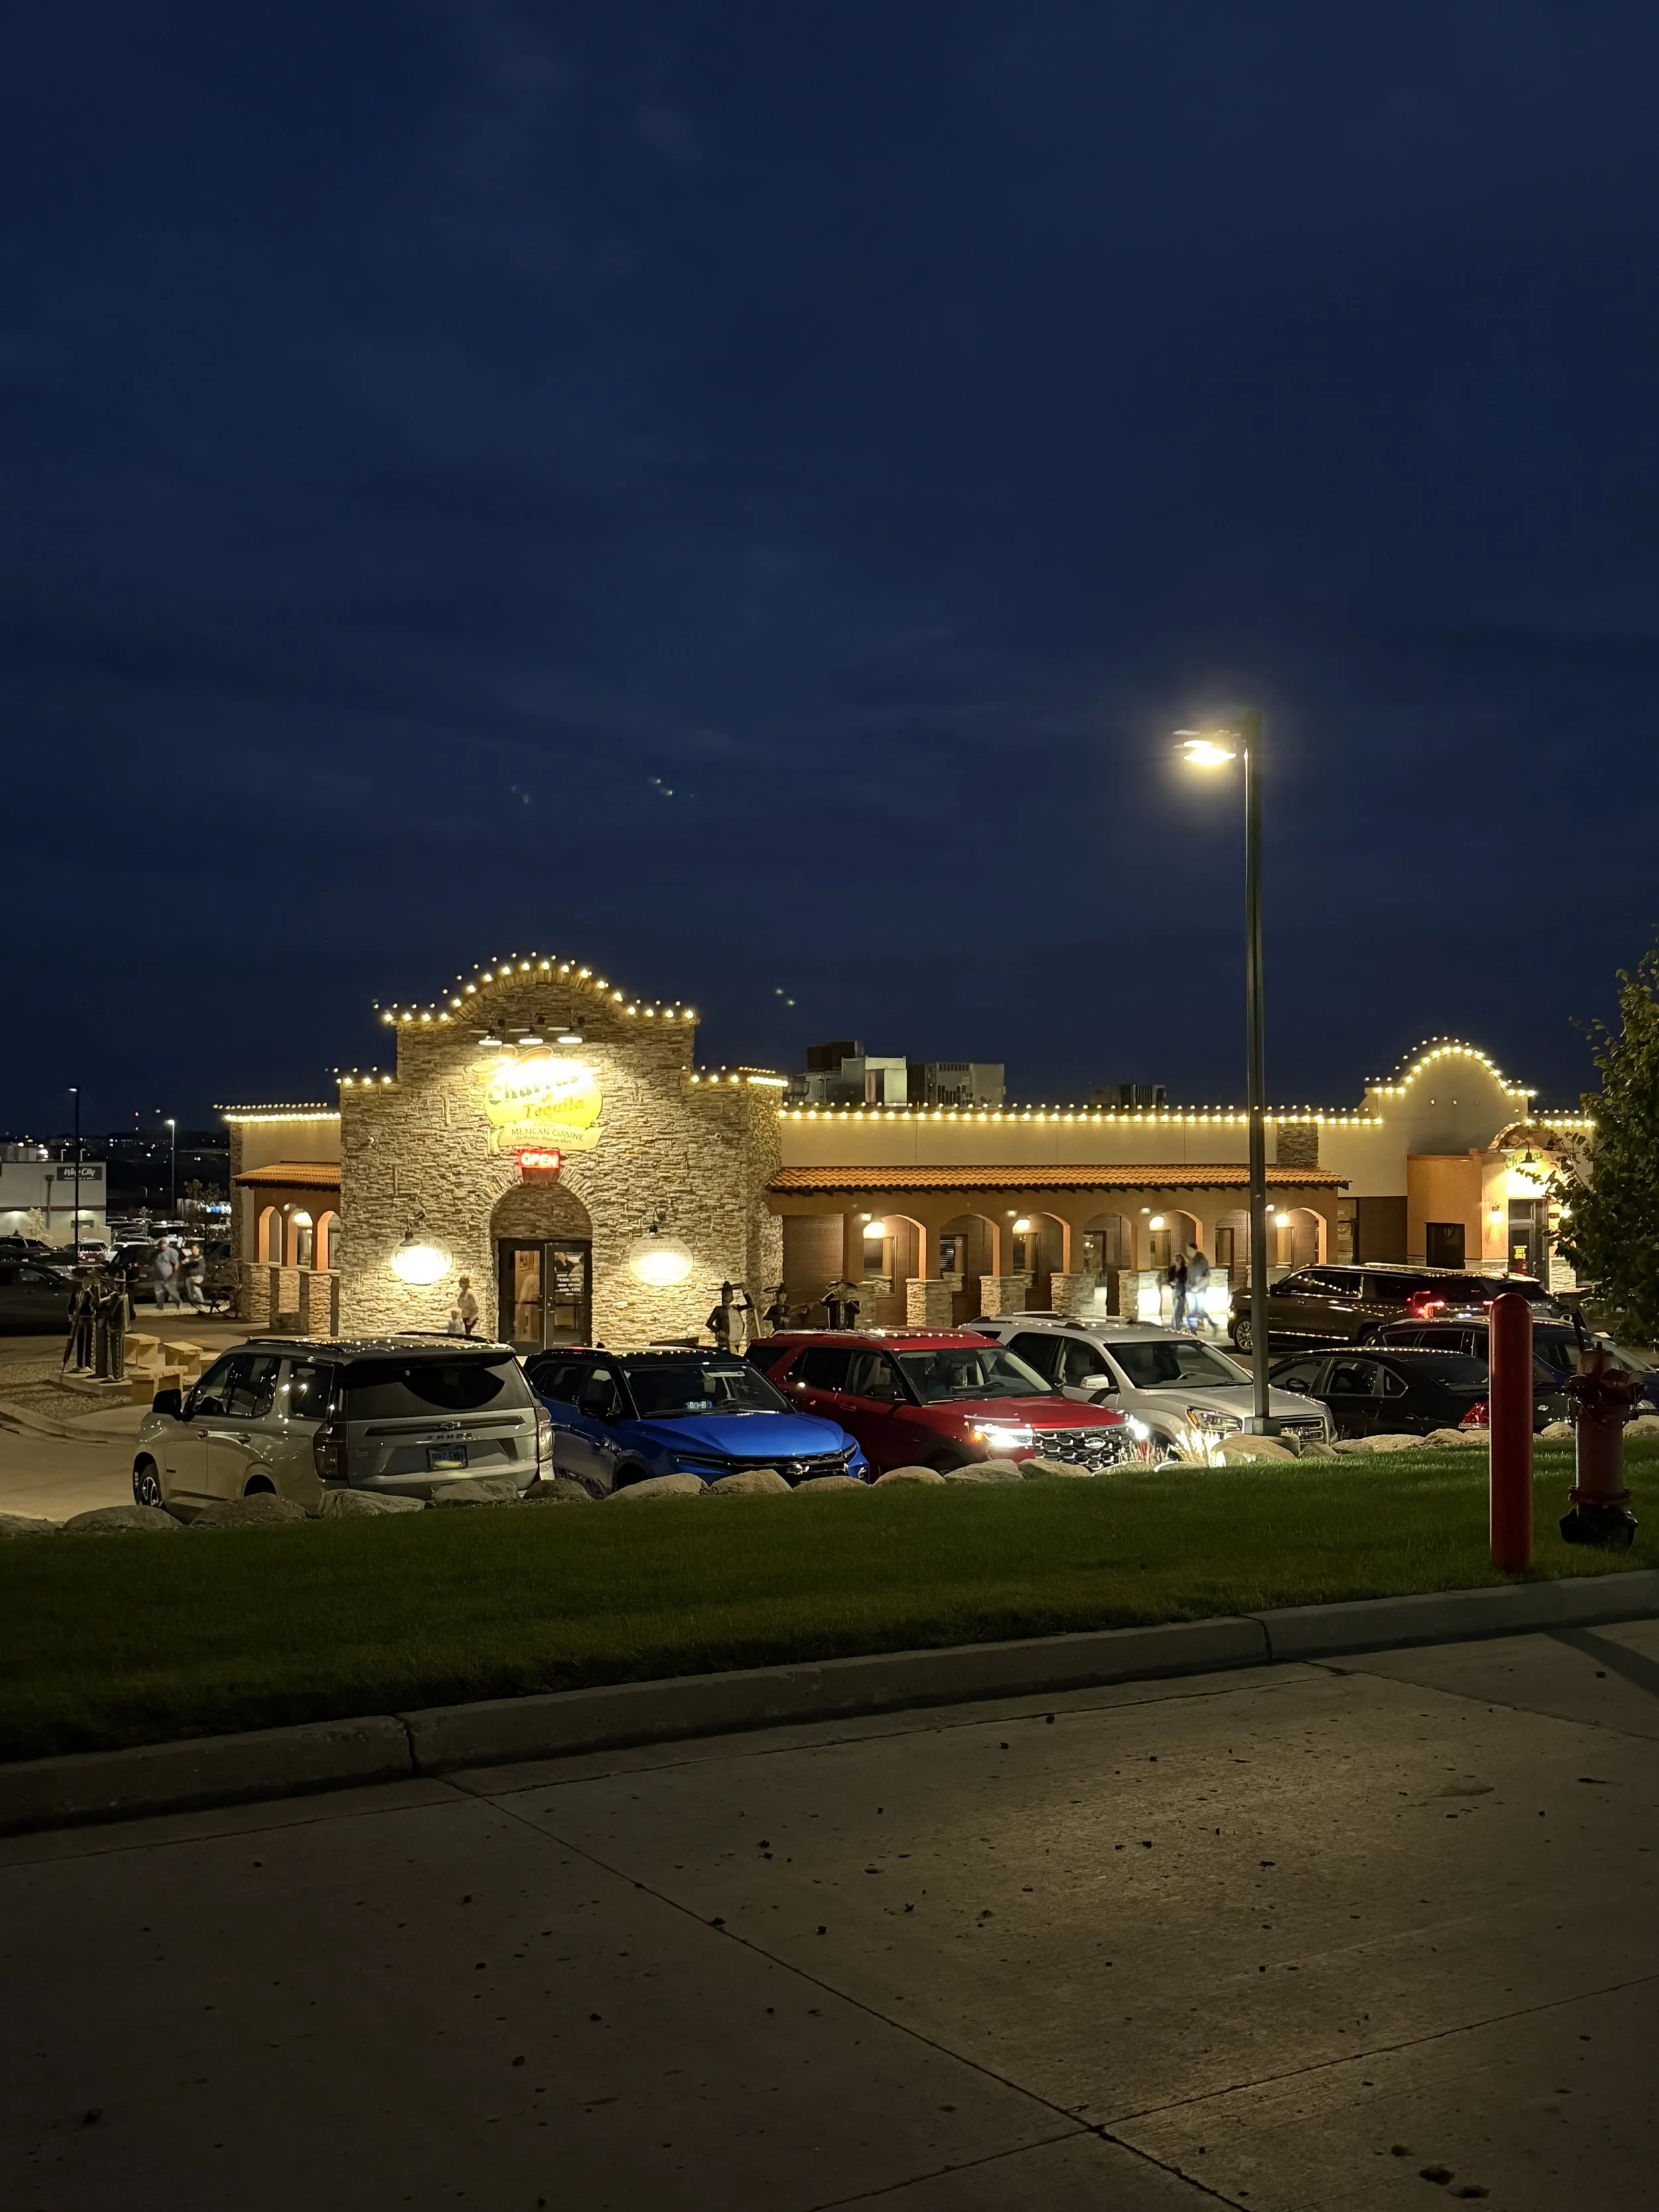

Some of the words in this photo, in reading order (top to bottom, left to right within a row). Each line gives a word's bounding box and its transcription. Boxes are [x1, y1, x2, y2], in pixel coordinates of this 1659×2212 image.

[524, 1096, 585, 1118] Tequila
[552, 1129, 585, 1142] CUISINE
[521, 1151, 558, 1167] OPEN
